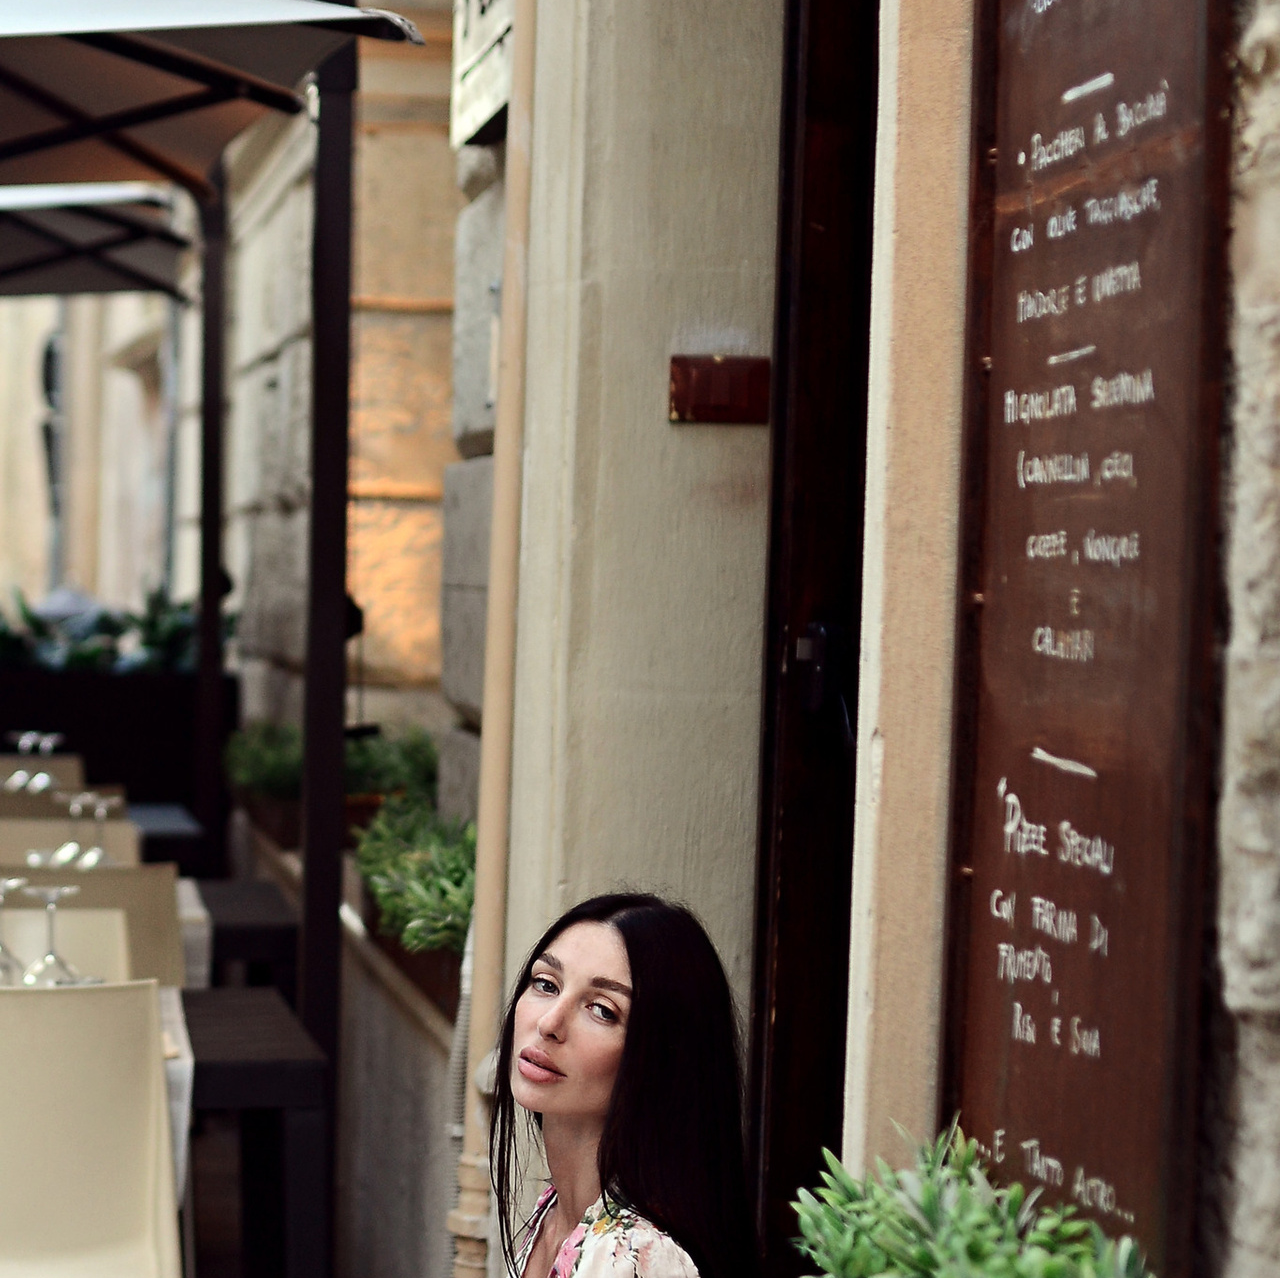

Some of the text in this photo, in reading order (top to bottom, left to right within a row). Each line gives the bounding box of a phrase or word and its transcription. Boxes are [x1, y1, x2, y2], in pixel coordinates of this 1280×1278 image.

[1010, 222, 1035, 254] CON
[1046, 205, 1078, 240] OLIVE
[989, 888, 1109, 958] CON FARINA DI
[1051, 1016, 1062, 1046] E
